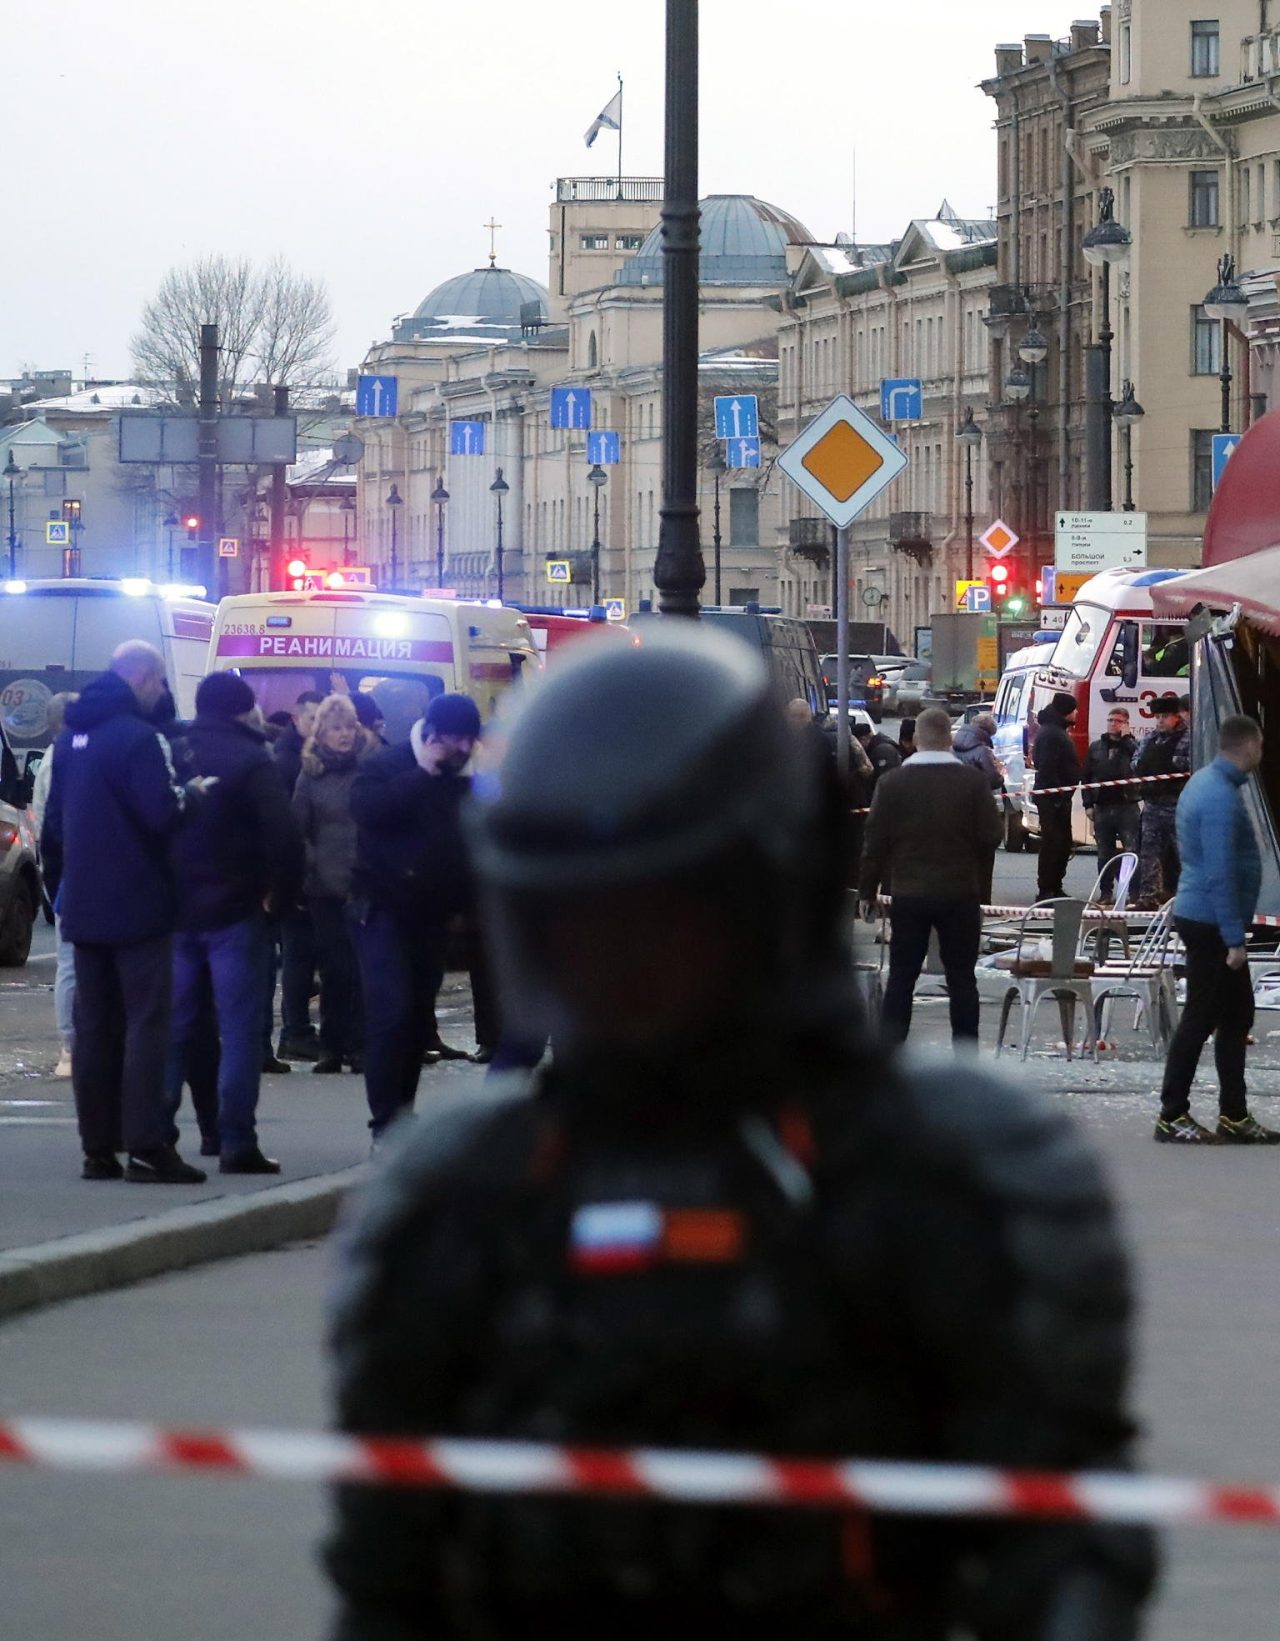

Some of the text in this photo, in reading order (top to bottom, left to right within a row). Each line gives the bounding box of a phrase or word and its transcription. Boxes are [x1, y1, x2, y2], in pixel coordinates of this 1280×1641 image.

[1071, 552, 1105, 560] БОЛЬШОЙ
[259, 637, 412, 659] РЕАНИМАЦИЯ
[3, 689, 24, 706] 03
